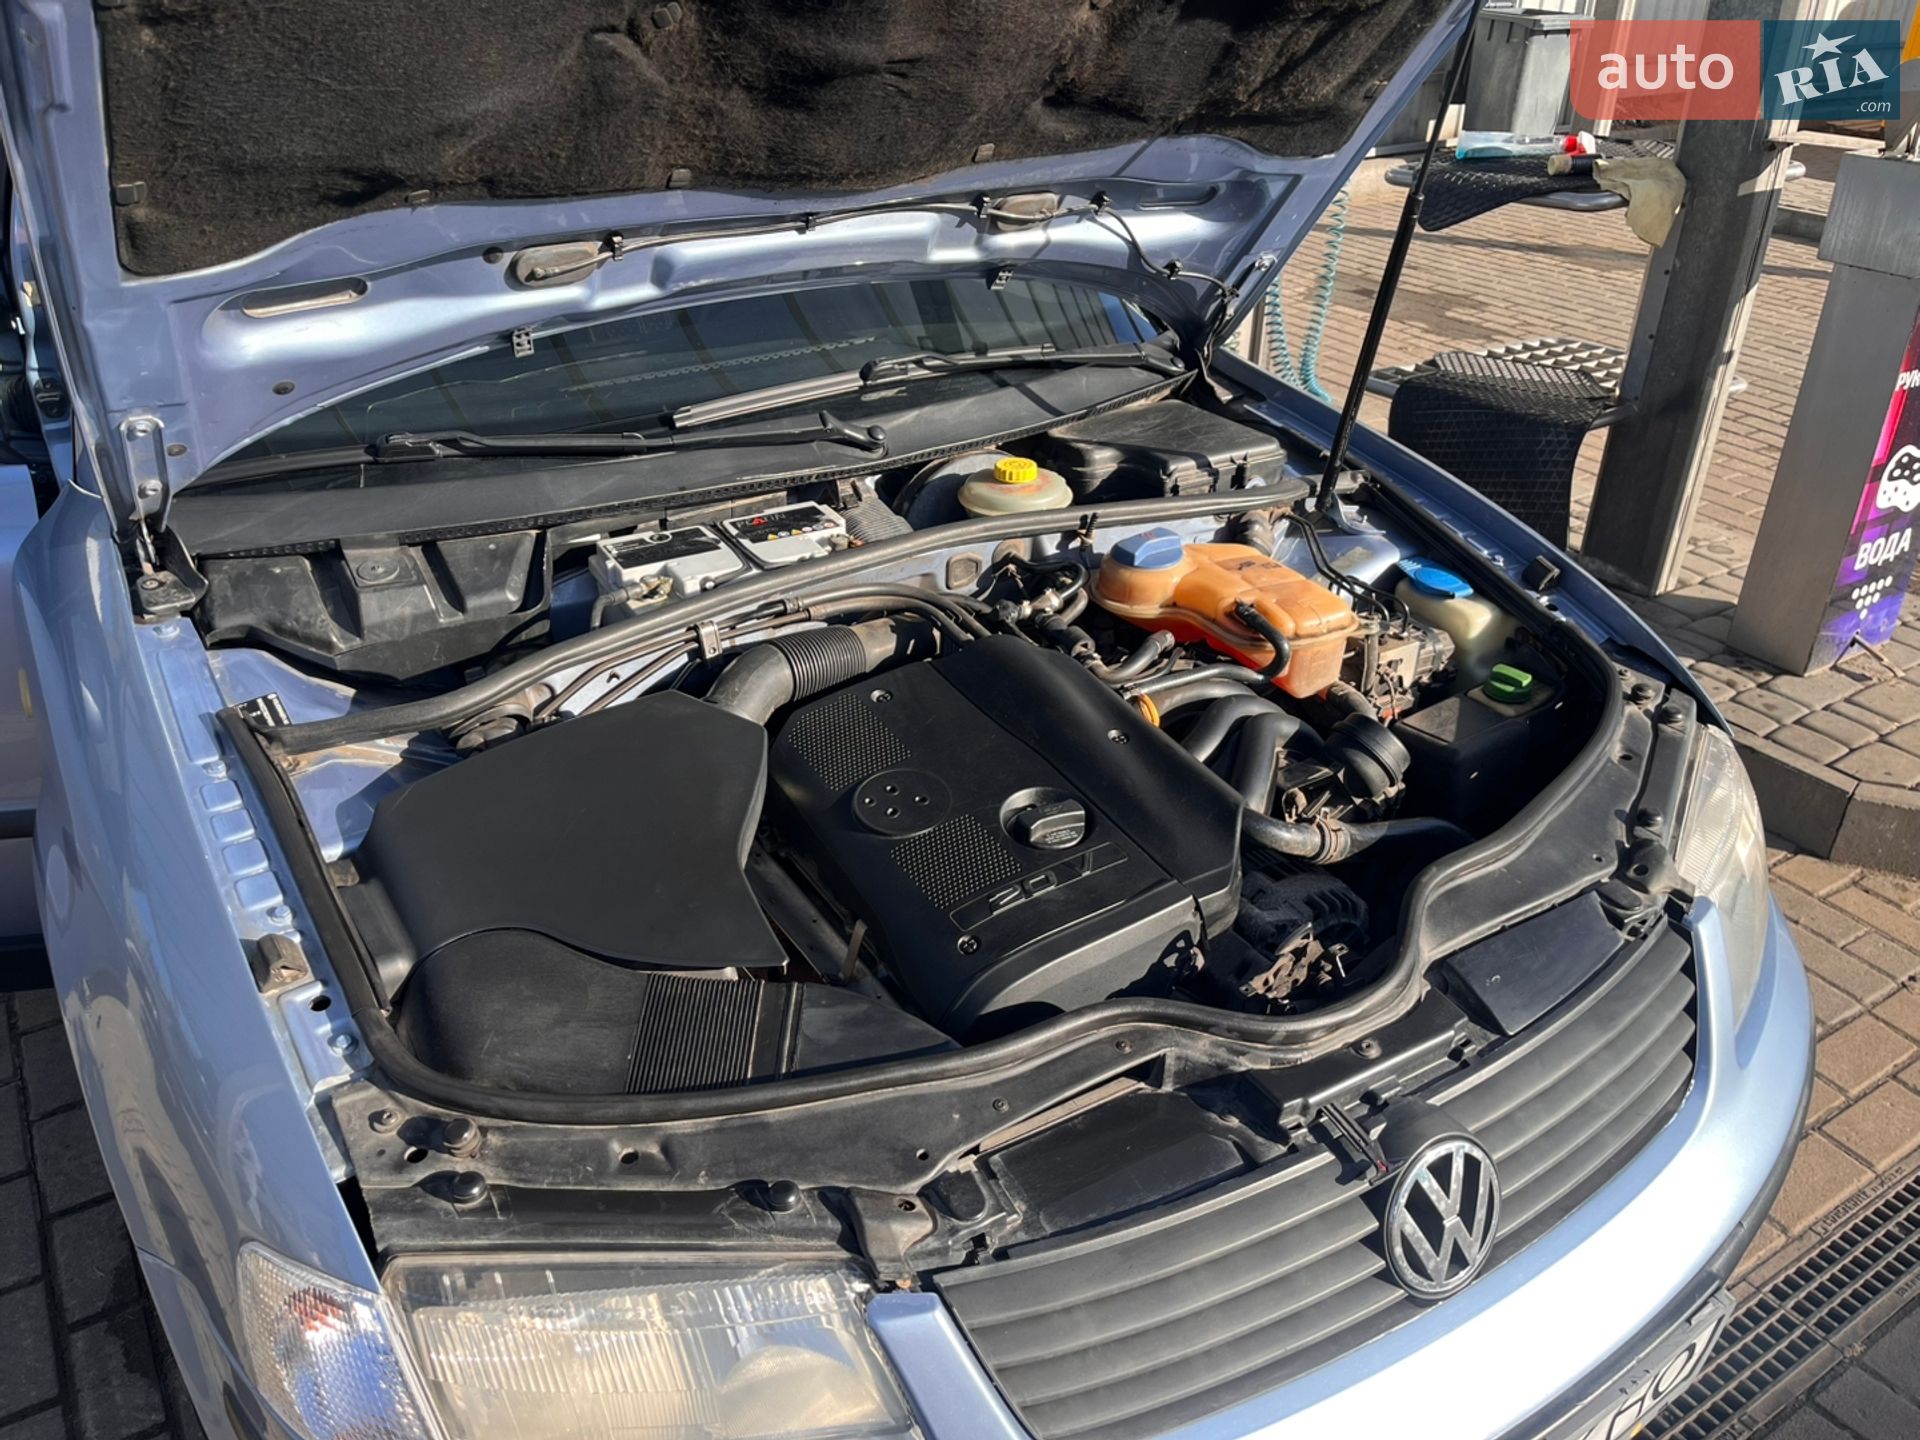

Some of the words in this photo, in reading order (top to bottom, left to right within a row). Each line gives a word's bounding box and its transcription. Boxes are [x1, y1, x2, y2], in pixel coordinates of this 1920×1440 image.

[1894, 369, 1920, 392] РУК
[1853, 527, 1912, 571] ВОДА
[1388, 1137, 1498, 1295] VW
